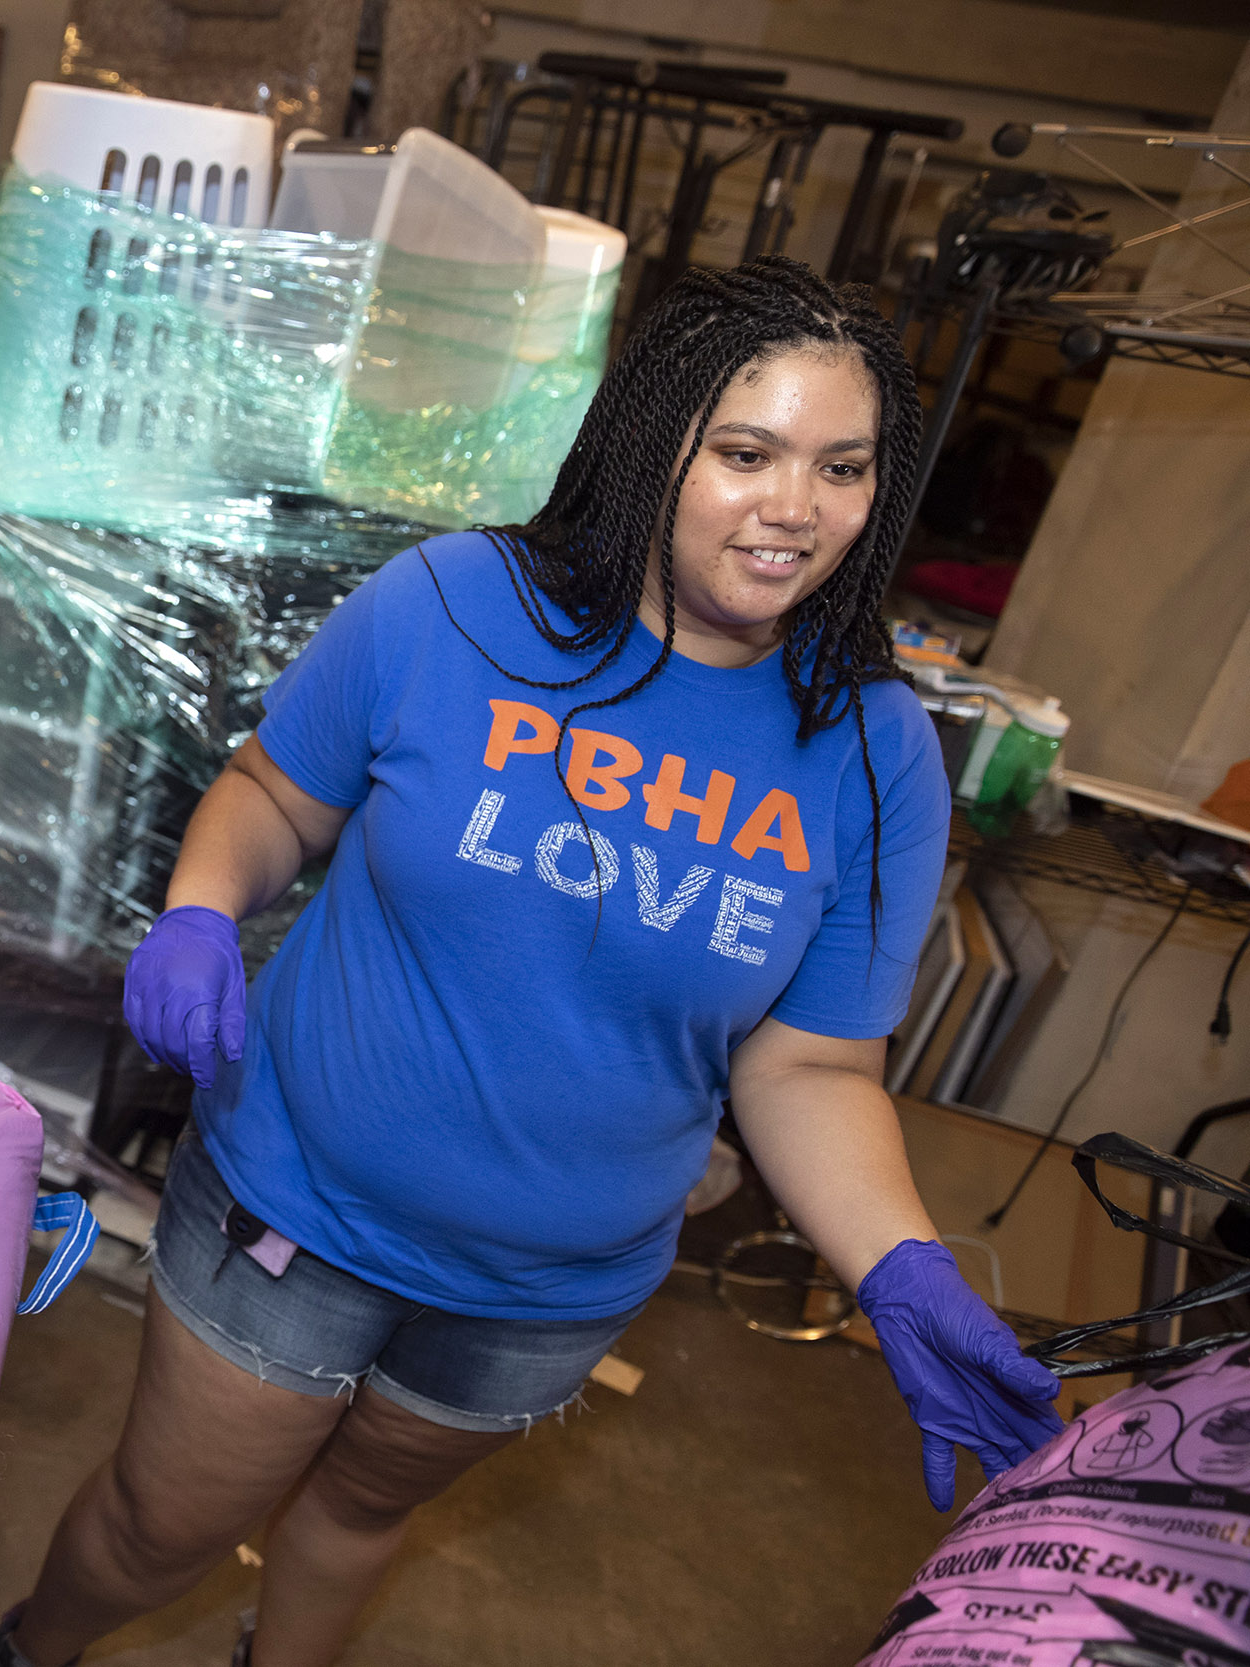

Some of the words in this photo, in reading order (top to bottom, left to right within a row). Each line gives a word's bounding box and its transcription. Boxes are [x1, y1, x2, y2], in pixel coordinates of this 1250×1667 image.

[483, 698, 811, 872] PBHA
[462, 795, 500, 859] Community
[551, 826, 566, 851] Love
[456, 788, 786, 966] LOVE
[725, 879, 783, 902] Compassion
[1007, 1540, 1100, 1575] THESE
[1096, 1552, 1195, 1596] EASY
